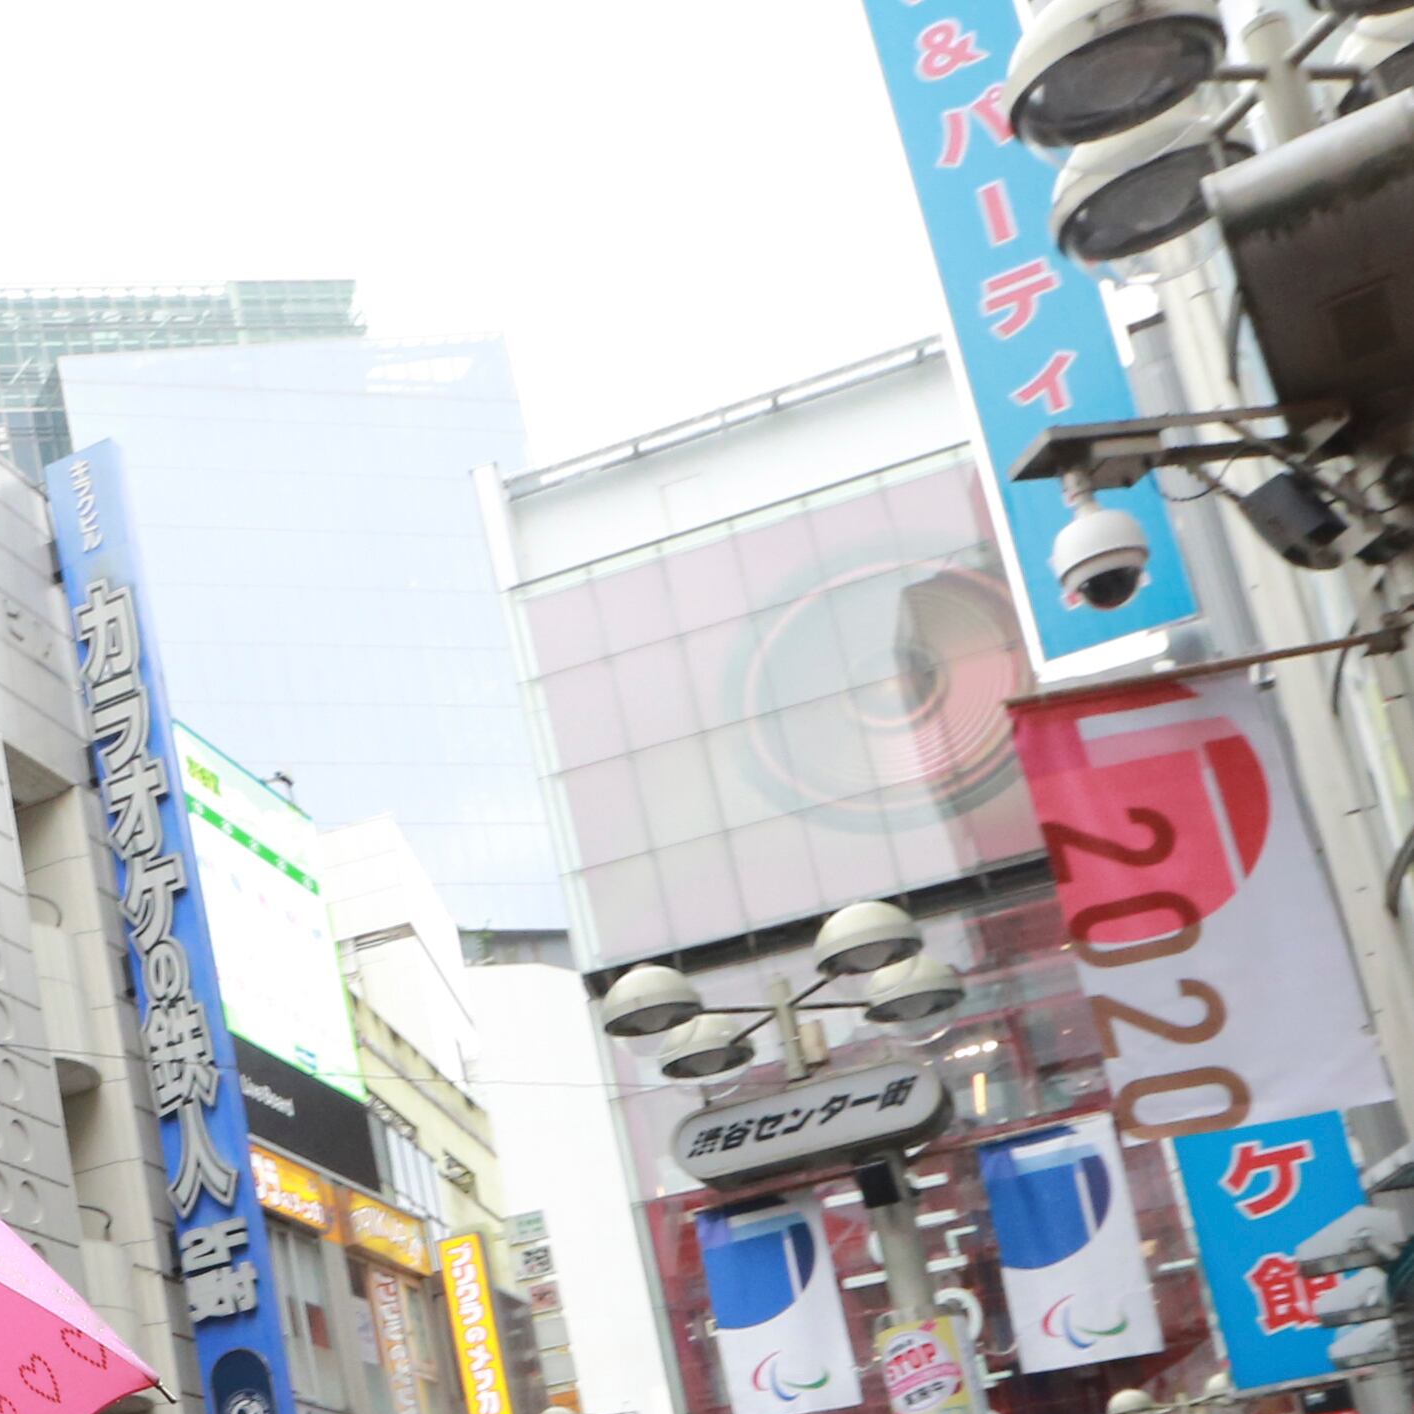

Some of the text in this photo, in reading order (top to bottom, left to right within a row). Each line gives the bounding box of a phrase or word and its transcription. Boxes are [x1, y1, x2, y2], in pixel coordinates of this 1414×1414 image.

[74, 576, 240, 1220] カラオケの鉄人
[1038, 805, 1253, 1142] 2020
[685, 1074, 920, 1160] 渋谷センター街
